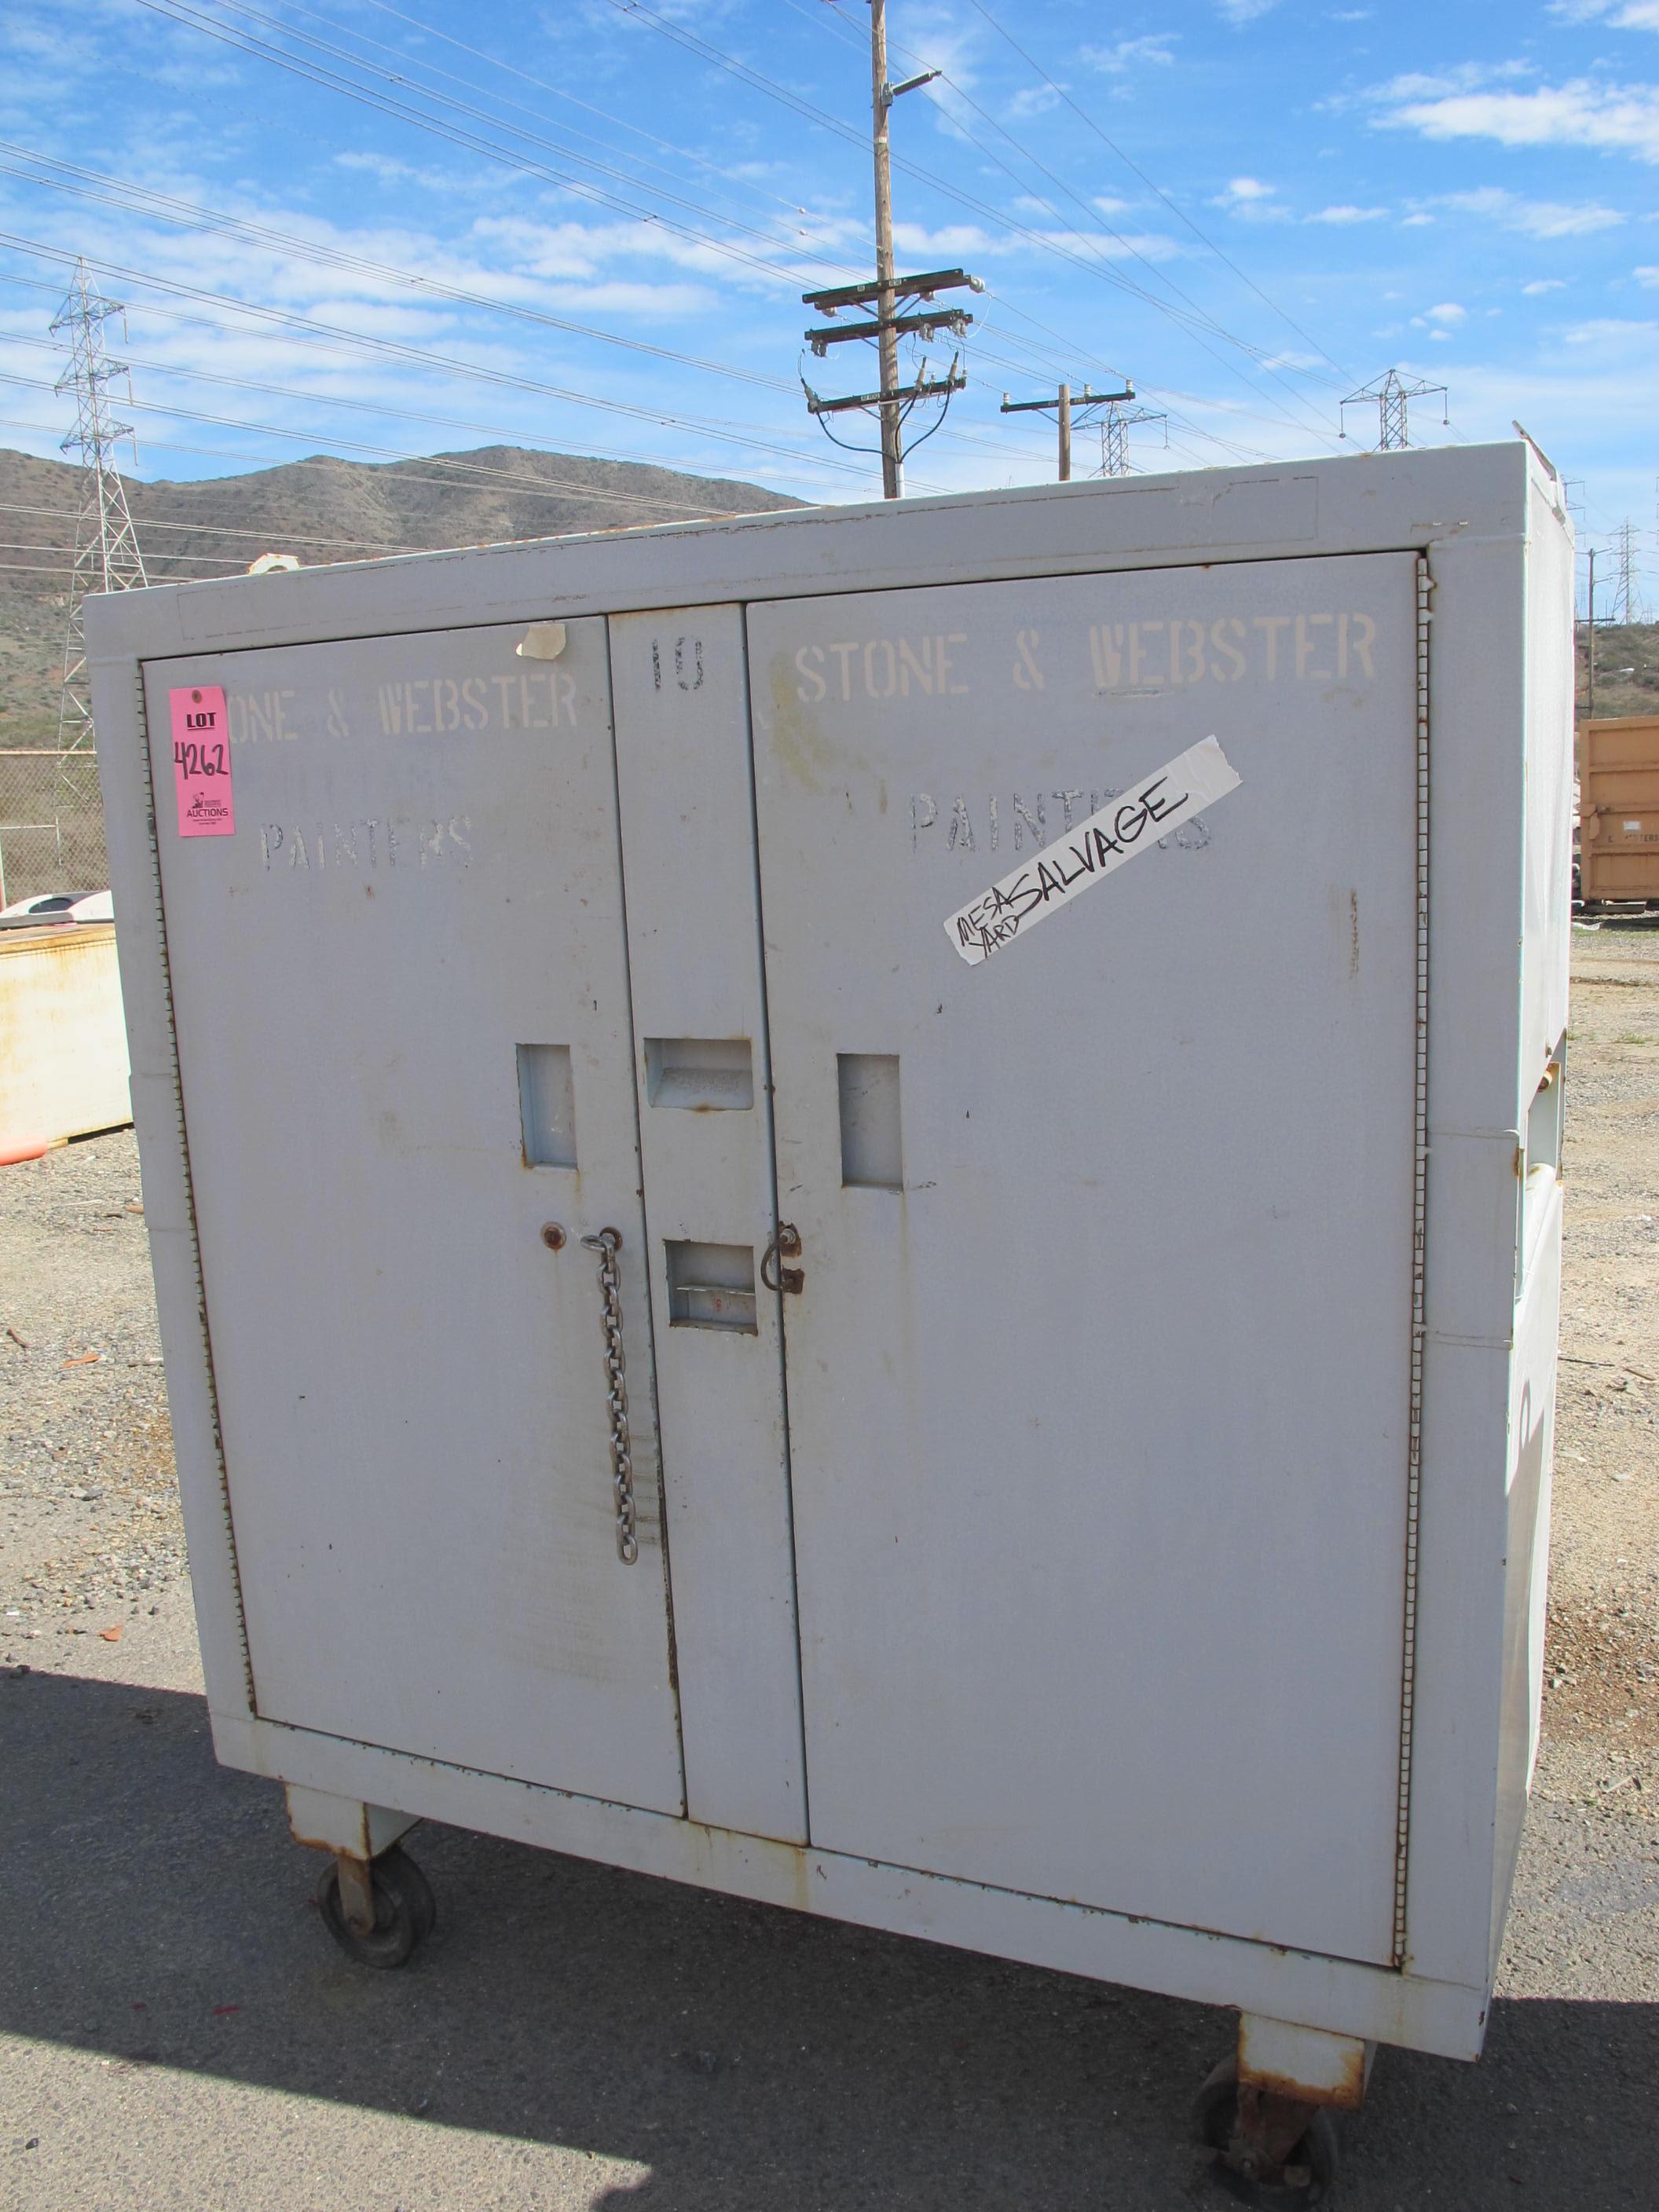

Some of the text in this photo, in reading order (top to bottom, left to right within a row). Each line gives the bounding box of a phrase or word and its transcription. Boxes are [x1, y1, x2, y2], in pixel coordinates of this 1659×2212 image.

[794, 612, 1376, 703] STONE & WEBSTER
[186, 712, 217, 728] LOT
[228, 672, 578, 743] ONE & WEBSTER
[174, 741, 229, 780] 4262
[186, 808, 229, 818] AUCTIONS
[909, 787, 1212, 855] PAINTS
[956, 775, 1189, 947] MESA SALVAGE
[967, 914, 1020, 960] YARD
